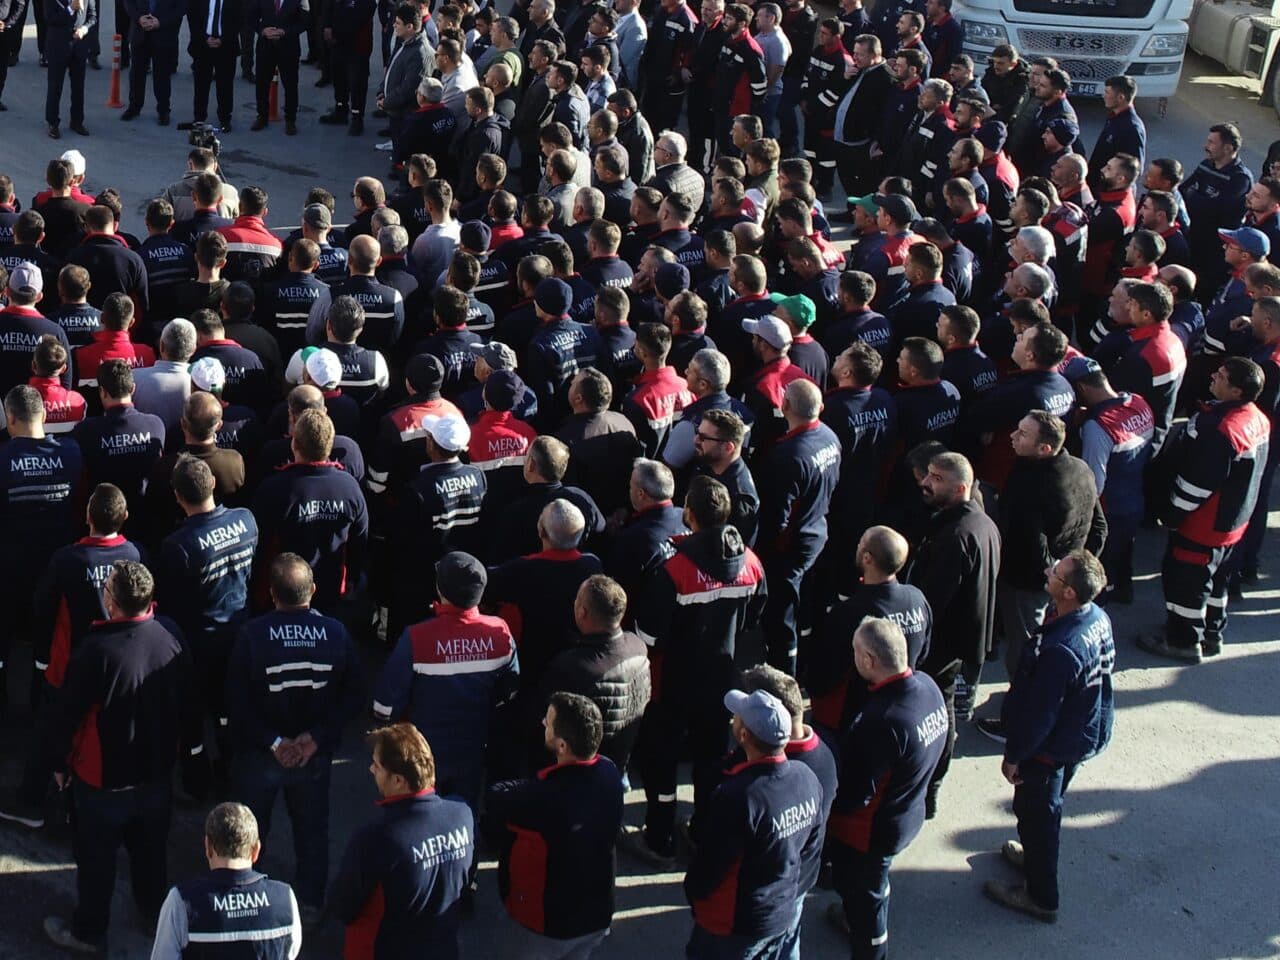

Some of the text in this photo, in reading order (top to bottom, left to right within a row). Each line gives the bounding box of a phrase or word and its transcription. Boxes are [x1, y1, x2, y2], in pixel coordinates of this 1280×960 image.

[1078, 83, 1095, 93] 645
[149, 246, 184, 258] MERAM
[319, 253, 345, 264] ERAM
[278, 287, 319, 299] MERAM
[58, 317, 99, 327] MERAM
[42, 400, 72, 412] RAM
[849, 408, 888, 425] MERAM
[101, 432, 151, 448] MERAM
[10, 457, 63, 472] MERAM
[436, 476, 477, 495] MERAM
[299, 500, 344, 516] MERAM
[198, 520, 248, 550] MERAM
[887, 608, 923, 627] ERAM
[270, 625, 327, 640] MERAM
[1082, 617, 1109, 645] MERAM
[284, 639, 316, 648] BELEDİYESİ
[436, 638, 494, 654] MERAM
[445, 652, 487, 663] BELEDİYESİ
[773, 799, 817, 832] MERAM
[414, 826, 470, 862] MERAM
[214, 891, 269, 911] MERAM
[227, 909, 259, 919] BELEDİYESİ
